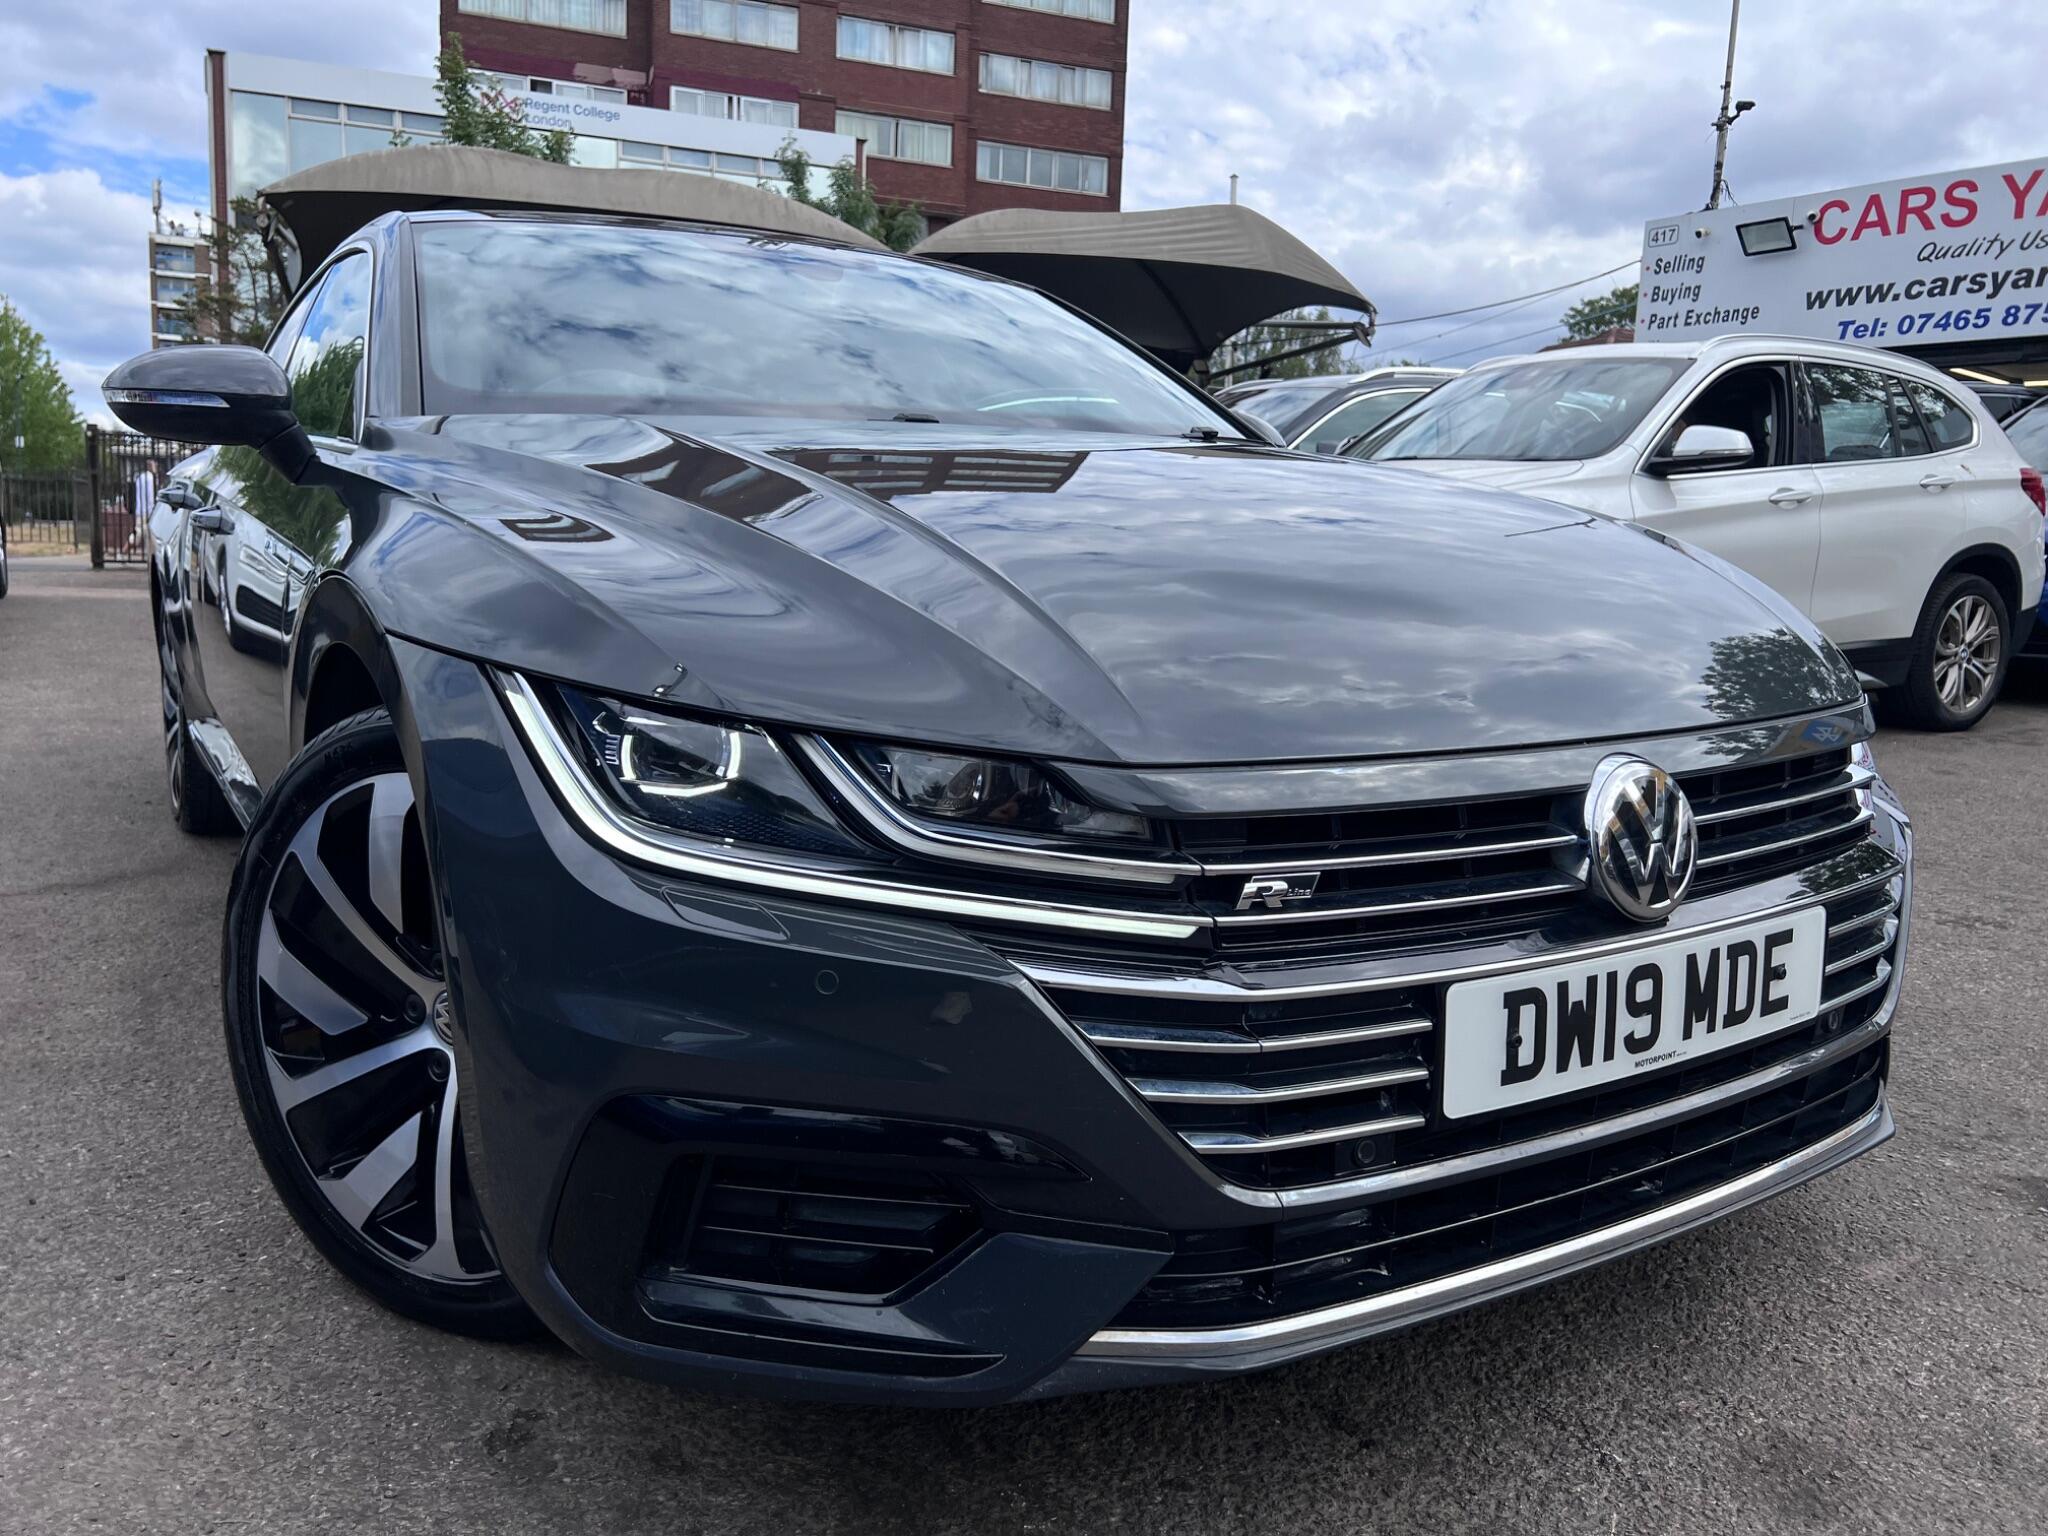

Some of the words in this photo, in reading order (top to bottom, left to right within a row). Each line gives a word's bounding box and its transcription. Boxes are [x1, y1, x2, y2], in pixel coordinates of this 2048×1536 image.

[523, 113, 573, 128] London
[524, 97, 570, 114] Regent
[573, 104, 621, 122] College
[1813, 179, 1979, 245] CARS
[2001, 168, 2048, 220] Y
[1651, 228, 1676, 244] 417
[1917, 232, 2015, 262] Quality
[2020, 228, 2048, 251] Us
[1653, 254, 1706, 275] Selling
[1650, 282, 1702, 305] Buying
[1647, 312, 1679, 330] Part
[1683, 305, 1760, 325] Exchange
[1838, 317, 1888, 340] Tel:
[1897, 307, 1992, 335] 07465
[1236, 881, 1288, 909] R
[1500, 962, 1664, 1087] DW19
[1682, 928, 1794, 1042] MDE
